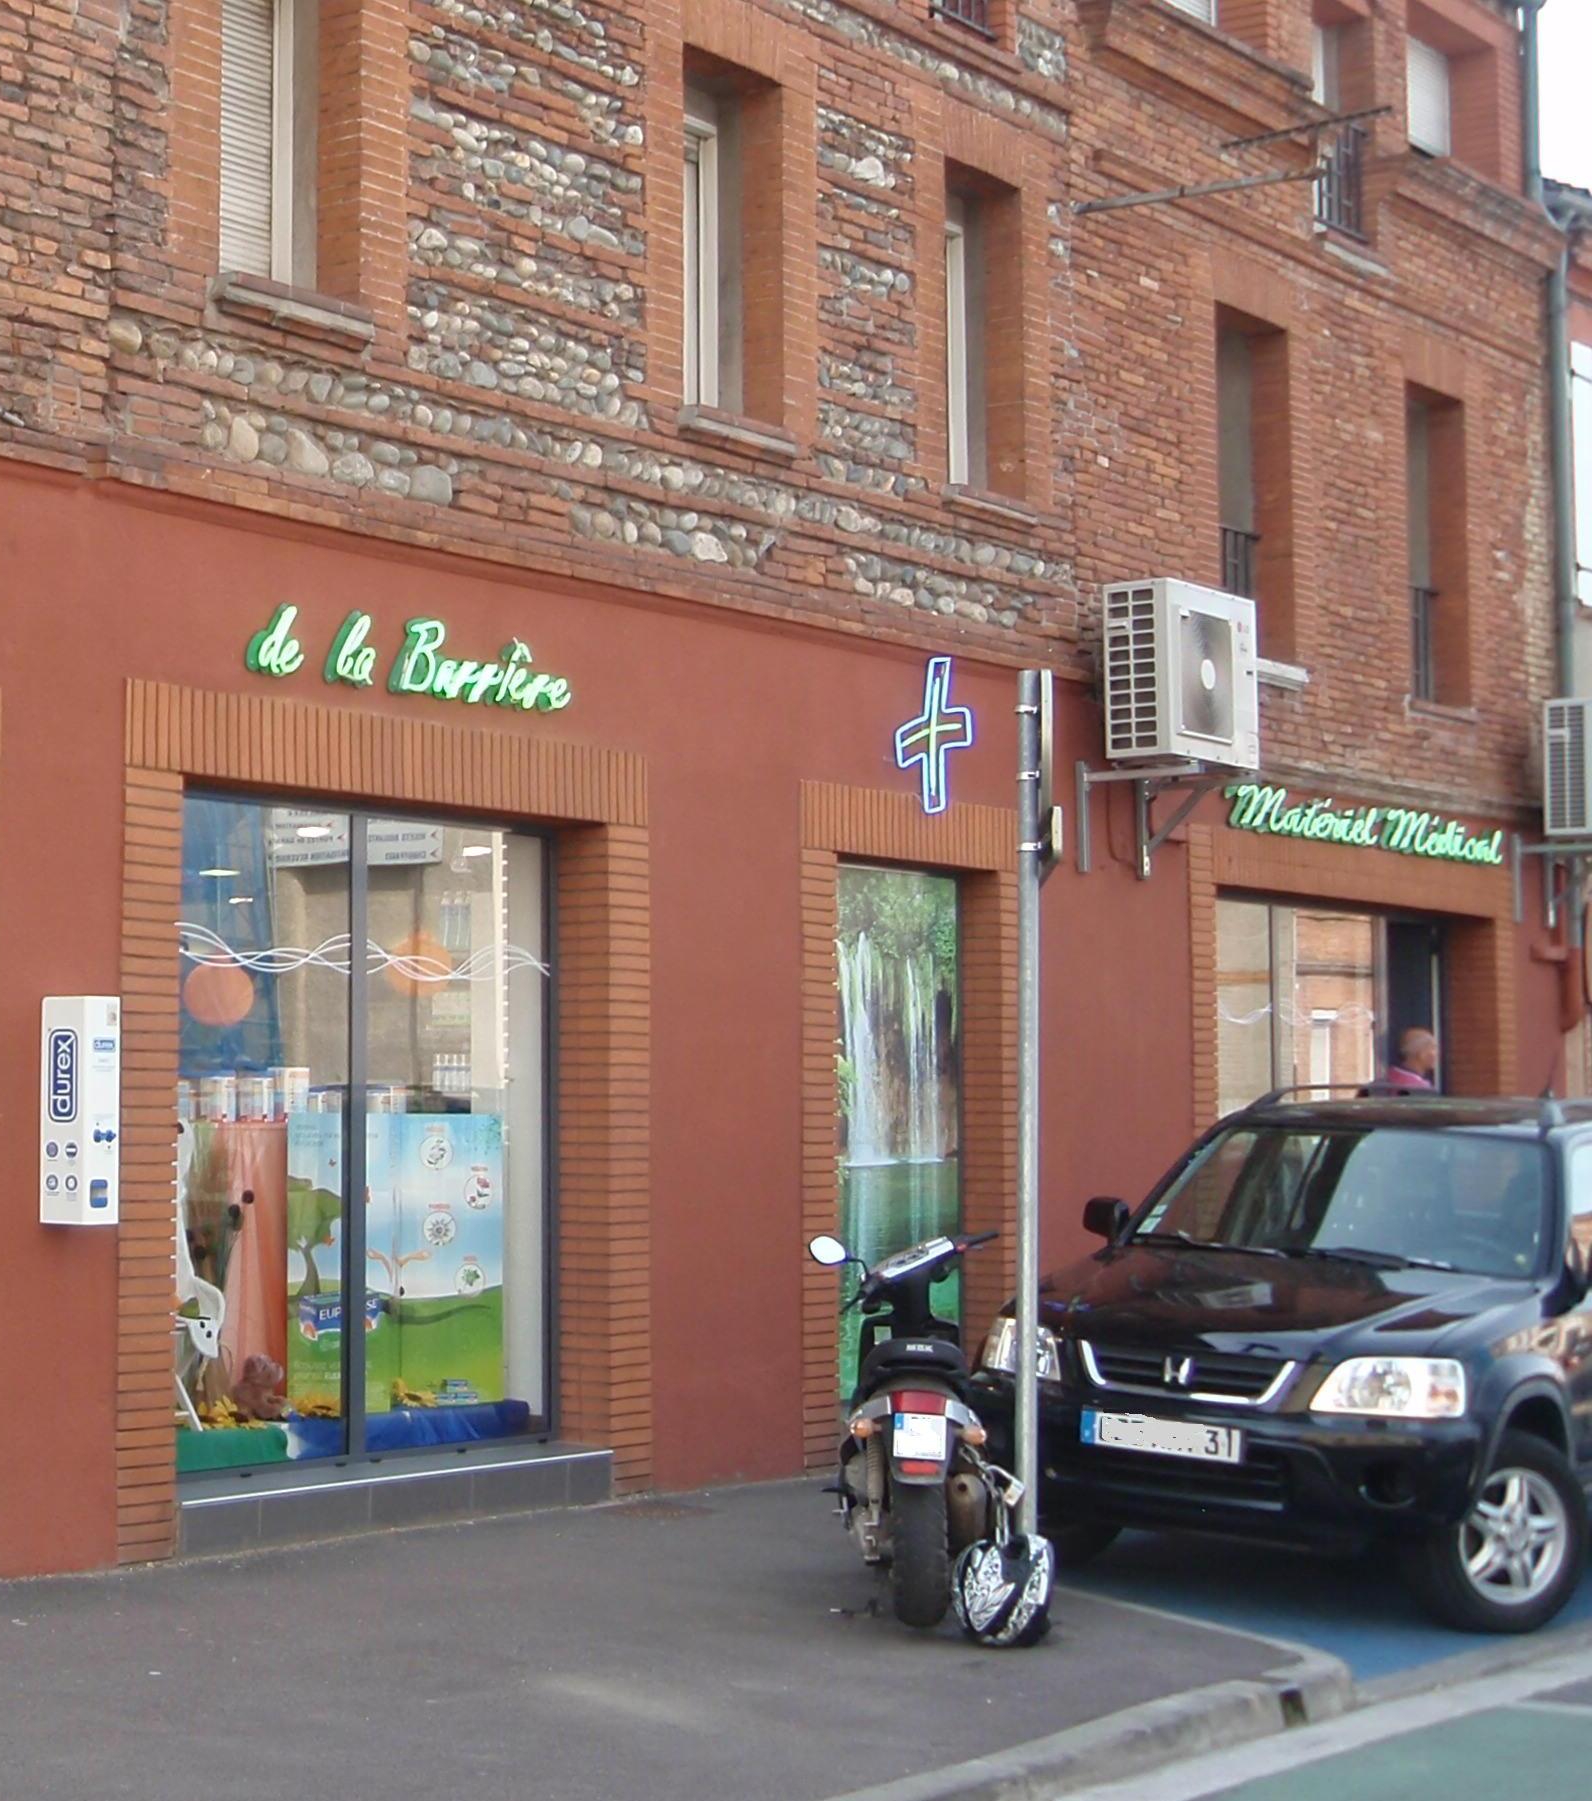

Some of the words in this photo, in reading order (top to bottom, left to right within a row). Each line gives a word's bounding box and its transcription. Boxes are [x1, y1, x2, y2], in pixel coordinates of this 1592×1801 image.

[246, 602, 304, 679] de
[324, 609, 377, 688] la
[1225, 784, 1380, 847] Matériel
[1382, 807, 1503, 865] Médical
[51, 1035, 75, 1113] durex
